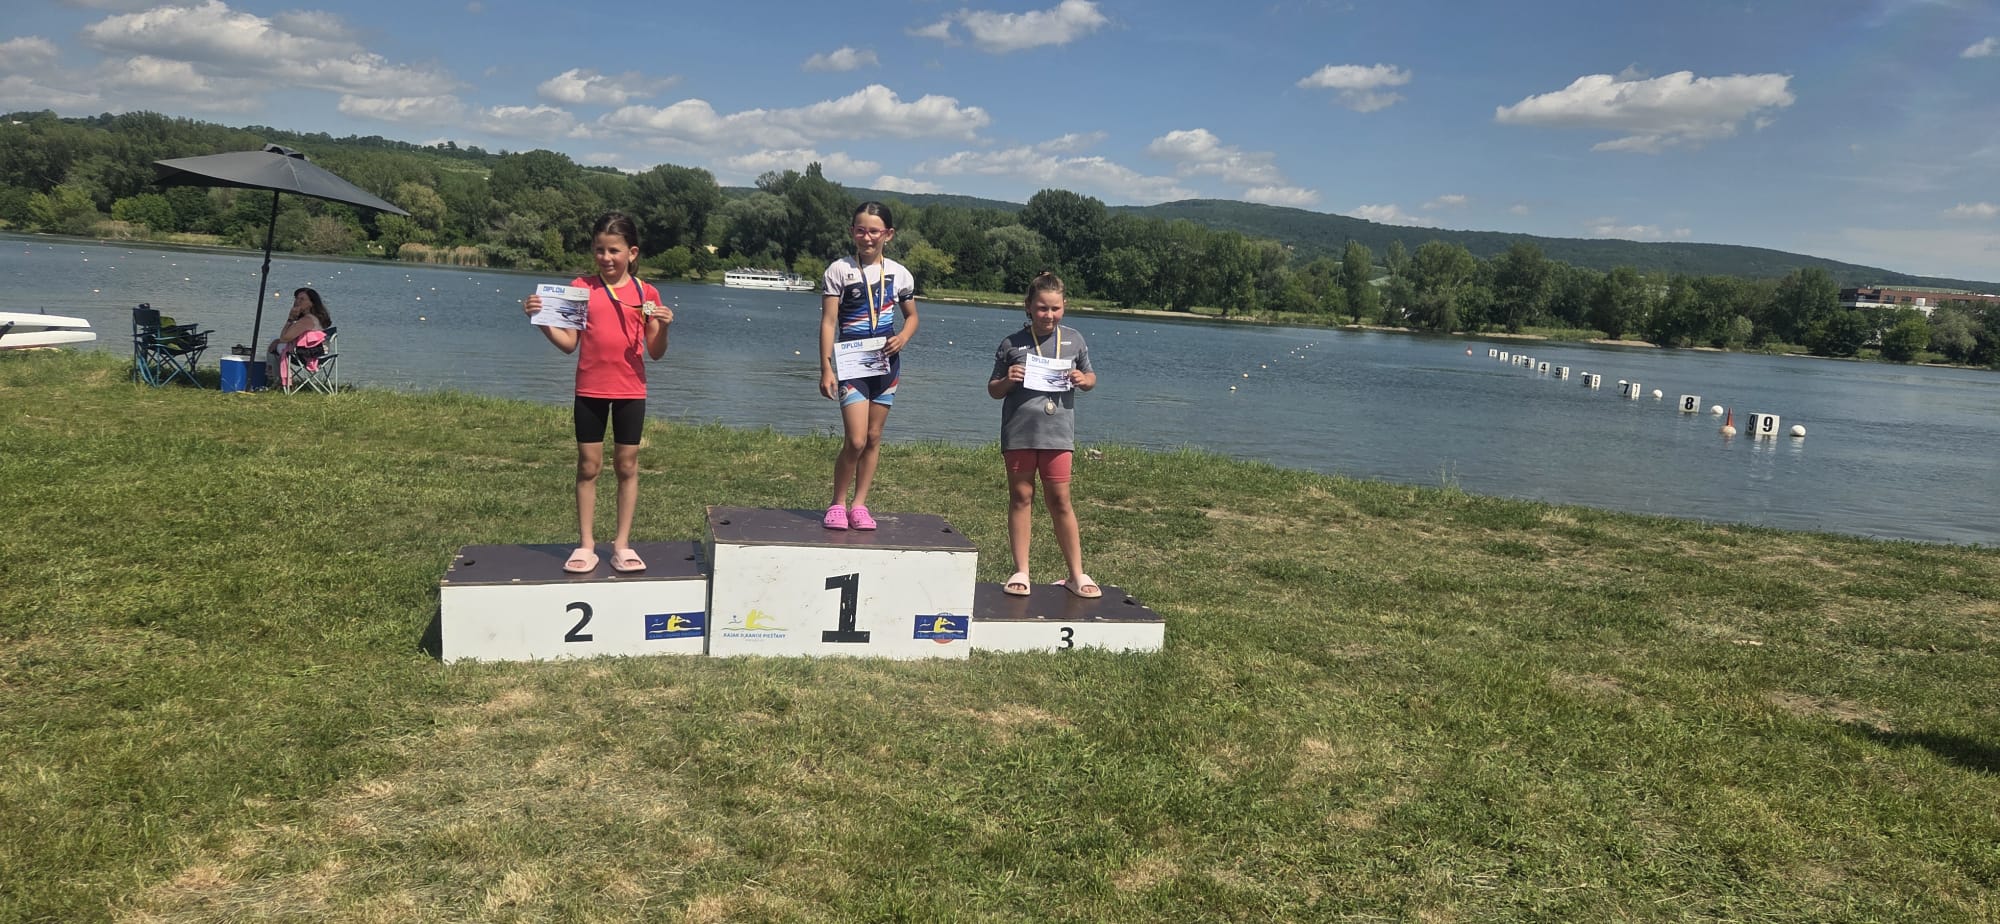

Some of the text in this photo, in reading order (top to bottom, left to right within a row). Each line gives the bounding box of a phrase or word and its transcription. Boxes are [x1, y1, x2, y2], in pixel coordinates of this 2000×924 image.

[543, 286, 566, 294] DIPLOM
[841, 340, 863, 349] DIPLOM
[1031, 355, 1050, 364] DIPLOM
[1540, 363, 1547, 371] 4
[1555, 367, 1561, 376] 5
[1583, 374, 1591, 385] 6
[1623, 383, 1630, 394] 7
[1684, 396, 1695, 410] 8
[1749, 414, 1756, 431] 9
[1762, 416, 1774, 432] 9
[822, 572, 871, 644] 1
[564, 601, 594, 643] 2
[1057, 626, 1075, 651] 3
